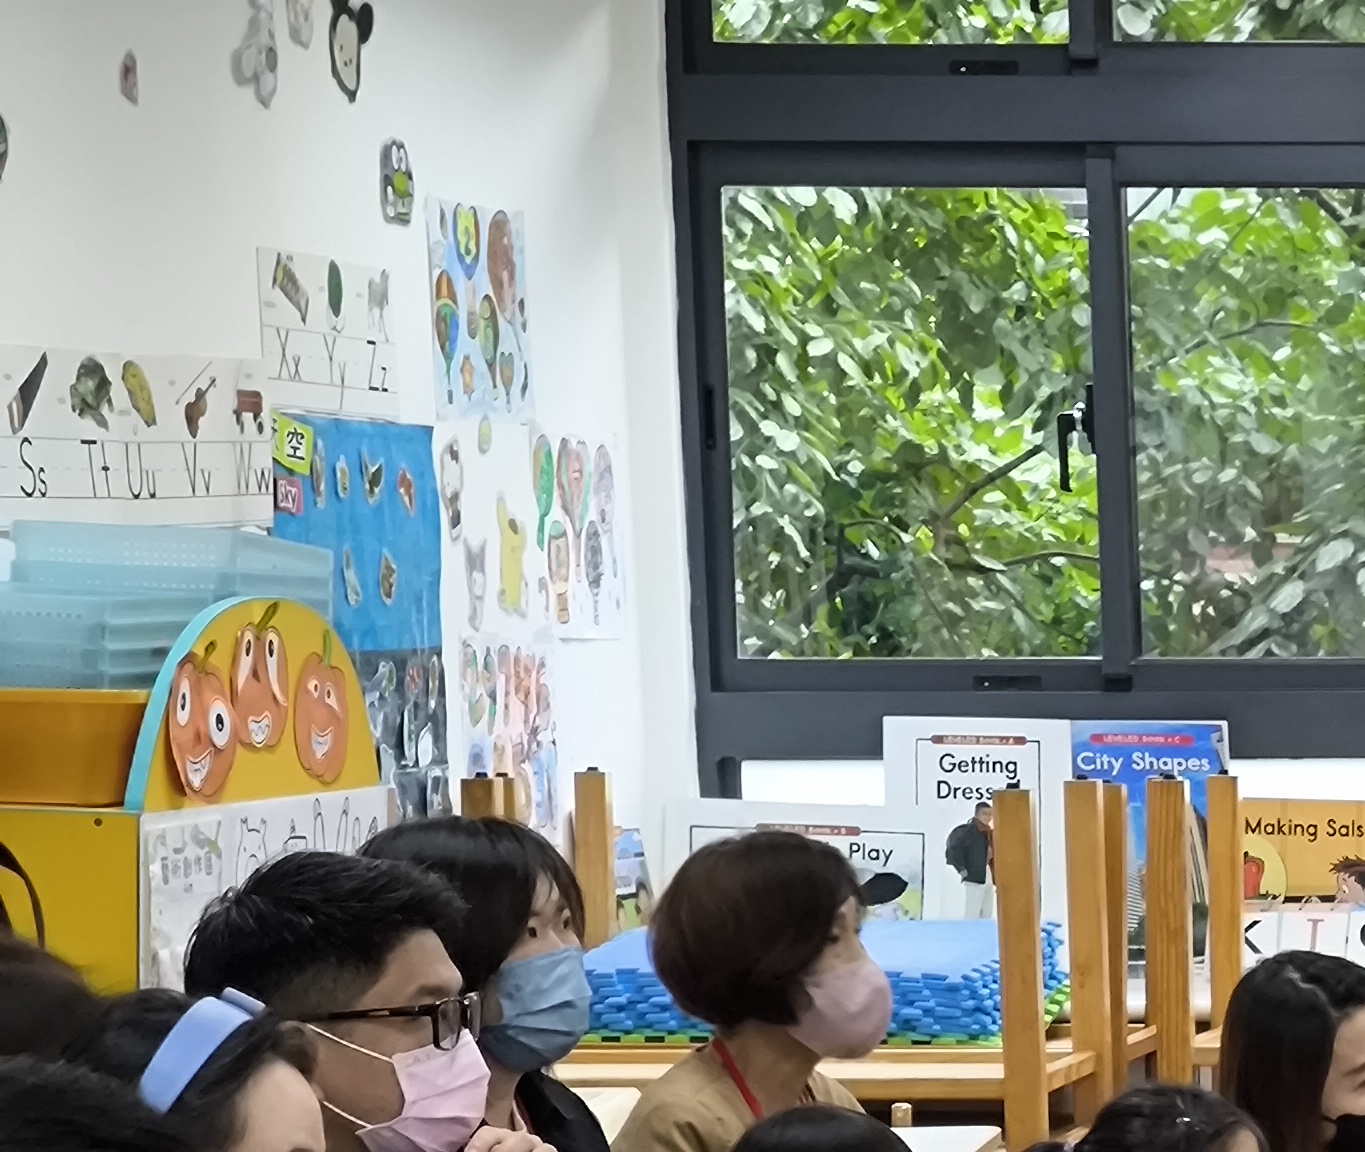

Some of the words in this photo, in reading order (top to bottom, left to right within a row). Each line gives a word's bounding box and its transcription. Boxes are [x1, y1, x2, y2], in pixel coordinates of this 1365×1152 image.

[20, 437, 48, 497] Ss
[939, 753, 1018, 780] Getting
[1076, 752, 1124, 776] City
[1131, 751, 1211, 776] Shapes
[937, 779, 1020, 800] Dress
[1245, 816, 1318, 843] Making
[849, 842, 893, 867] Play
